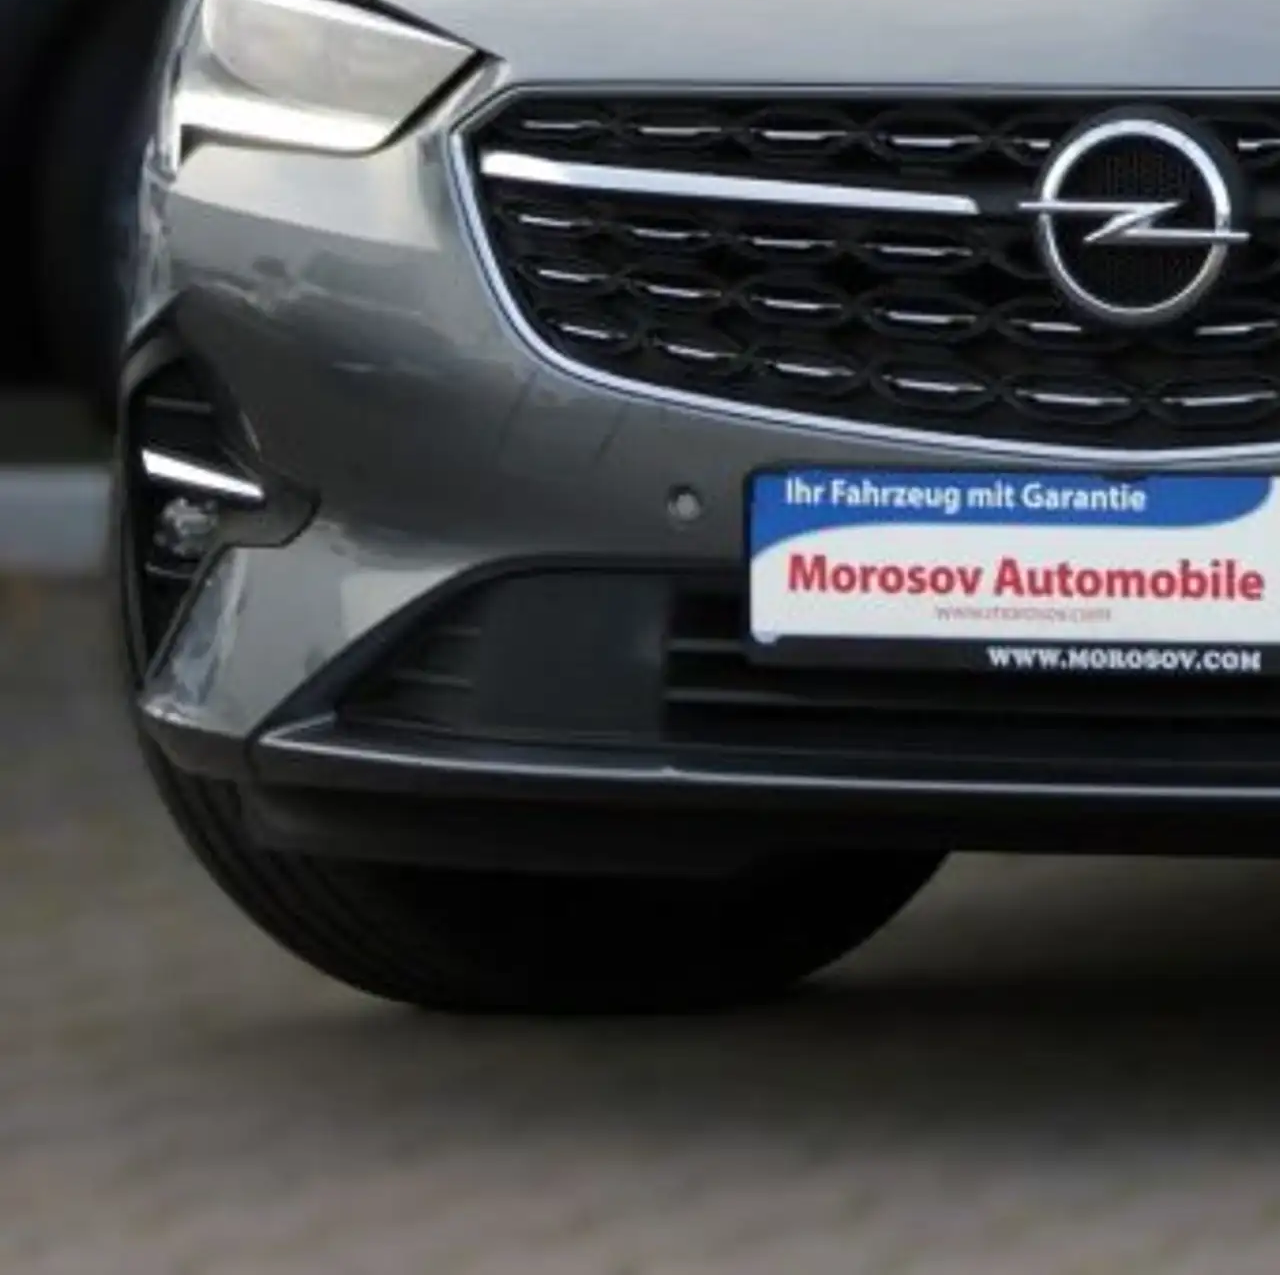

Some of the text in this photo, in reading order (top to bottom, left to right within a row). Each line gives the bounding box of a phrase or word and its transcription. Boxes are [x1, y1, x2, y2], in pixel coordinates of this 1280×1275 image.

[786, 477, 1147, 515] Ihr Fahrzeug mit Garantie
[788, 554, 1265, 601] Morosov Automobile
[987, 645, 1262, 672] WWW.MOROSOV.COM
